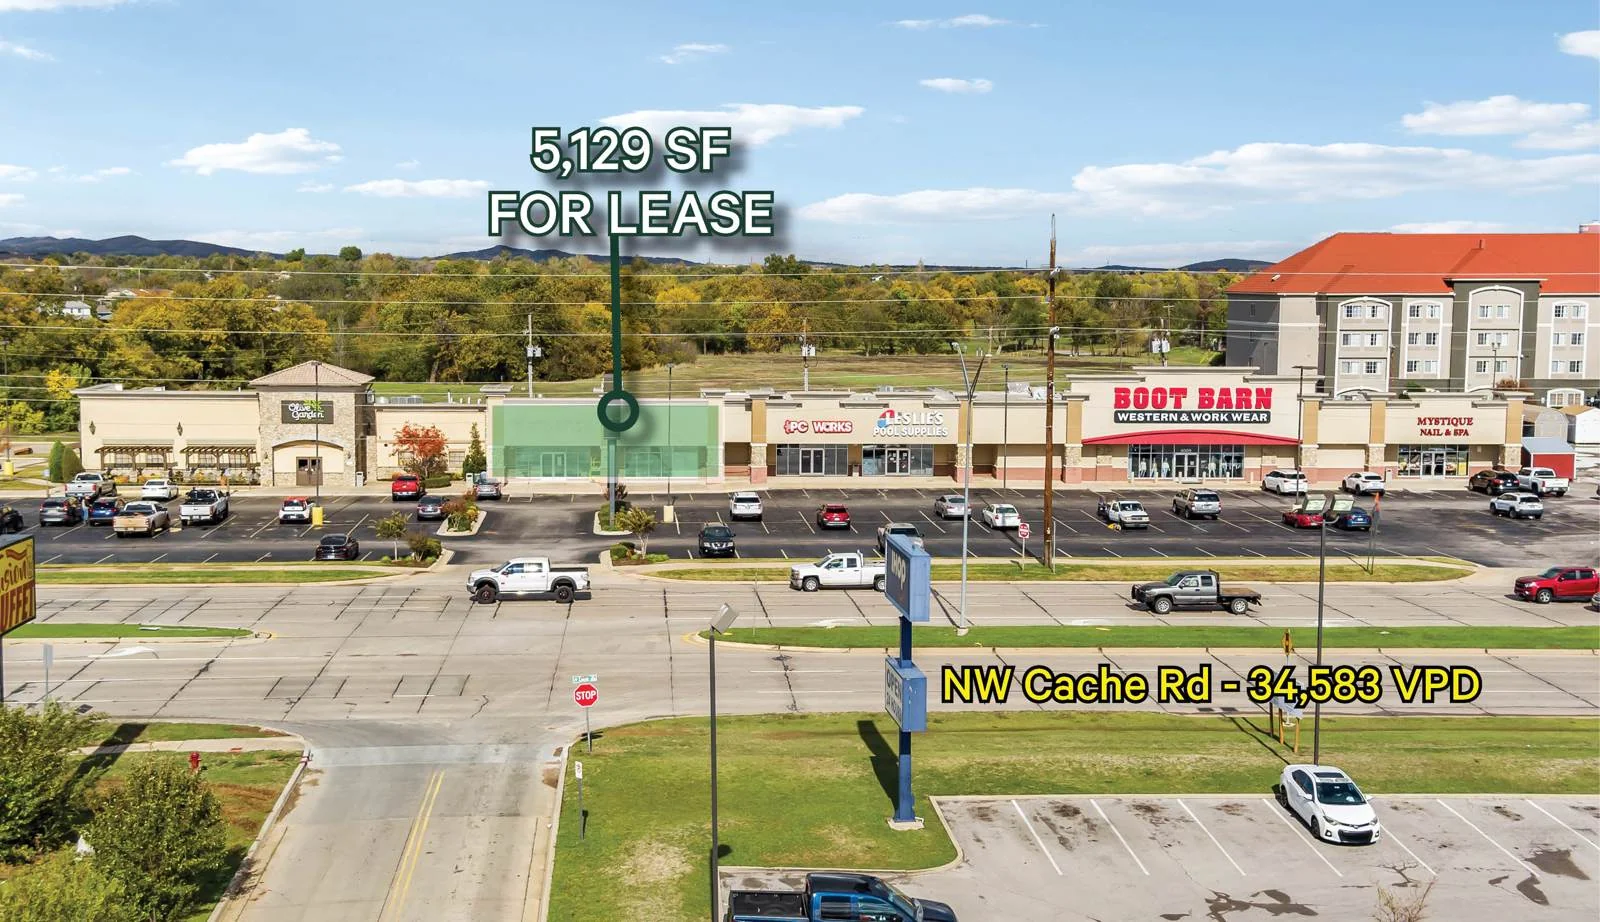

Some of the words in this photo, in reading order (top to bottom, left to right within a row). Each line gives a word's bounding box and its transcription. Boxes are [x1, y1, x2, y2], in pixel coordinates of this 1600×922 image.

[1113, 387, 1187, 409] BOOT
[1197, 387, 1272, 410] BARN
[289, 403, 311, 412] Olive
[1117, 412, 1178, 422] WESTERN
[1179, 412, 1190, 422] &
[1191, 412, 1229, 422] WORK
[1231, 412, 1268, 422] WEAR
[1417, 416, 1474, 427] MYSTIQUE
[790, 420, 809, 433] PC
[813, 421, 853, 433] WORKS
[873, 427, 900, 437] POOL
[901, 427, 949, 437] SUPPLIES
[1420, 428, 1443, 437] NAIL
[1444, 428, 1452, 436] &
[1453, 428, 1470, 437] SPA
[575, 690, 597, 701] STOP
